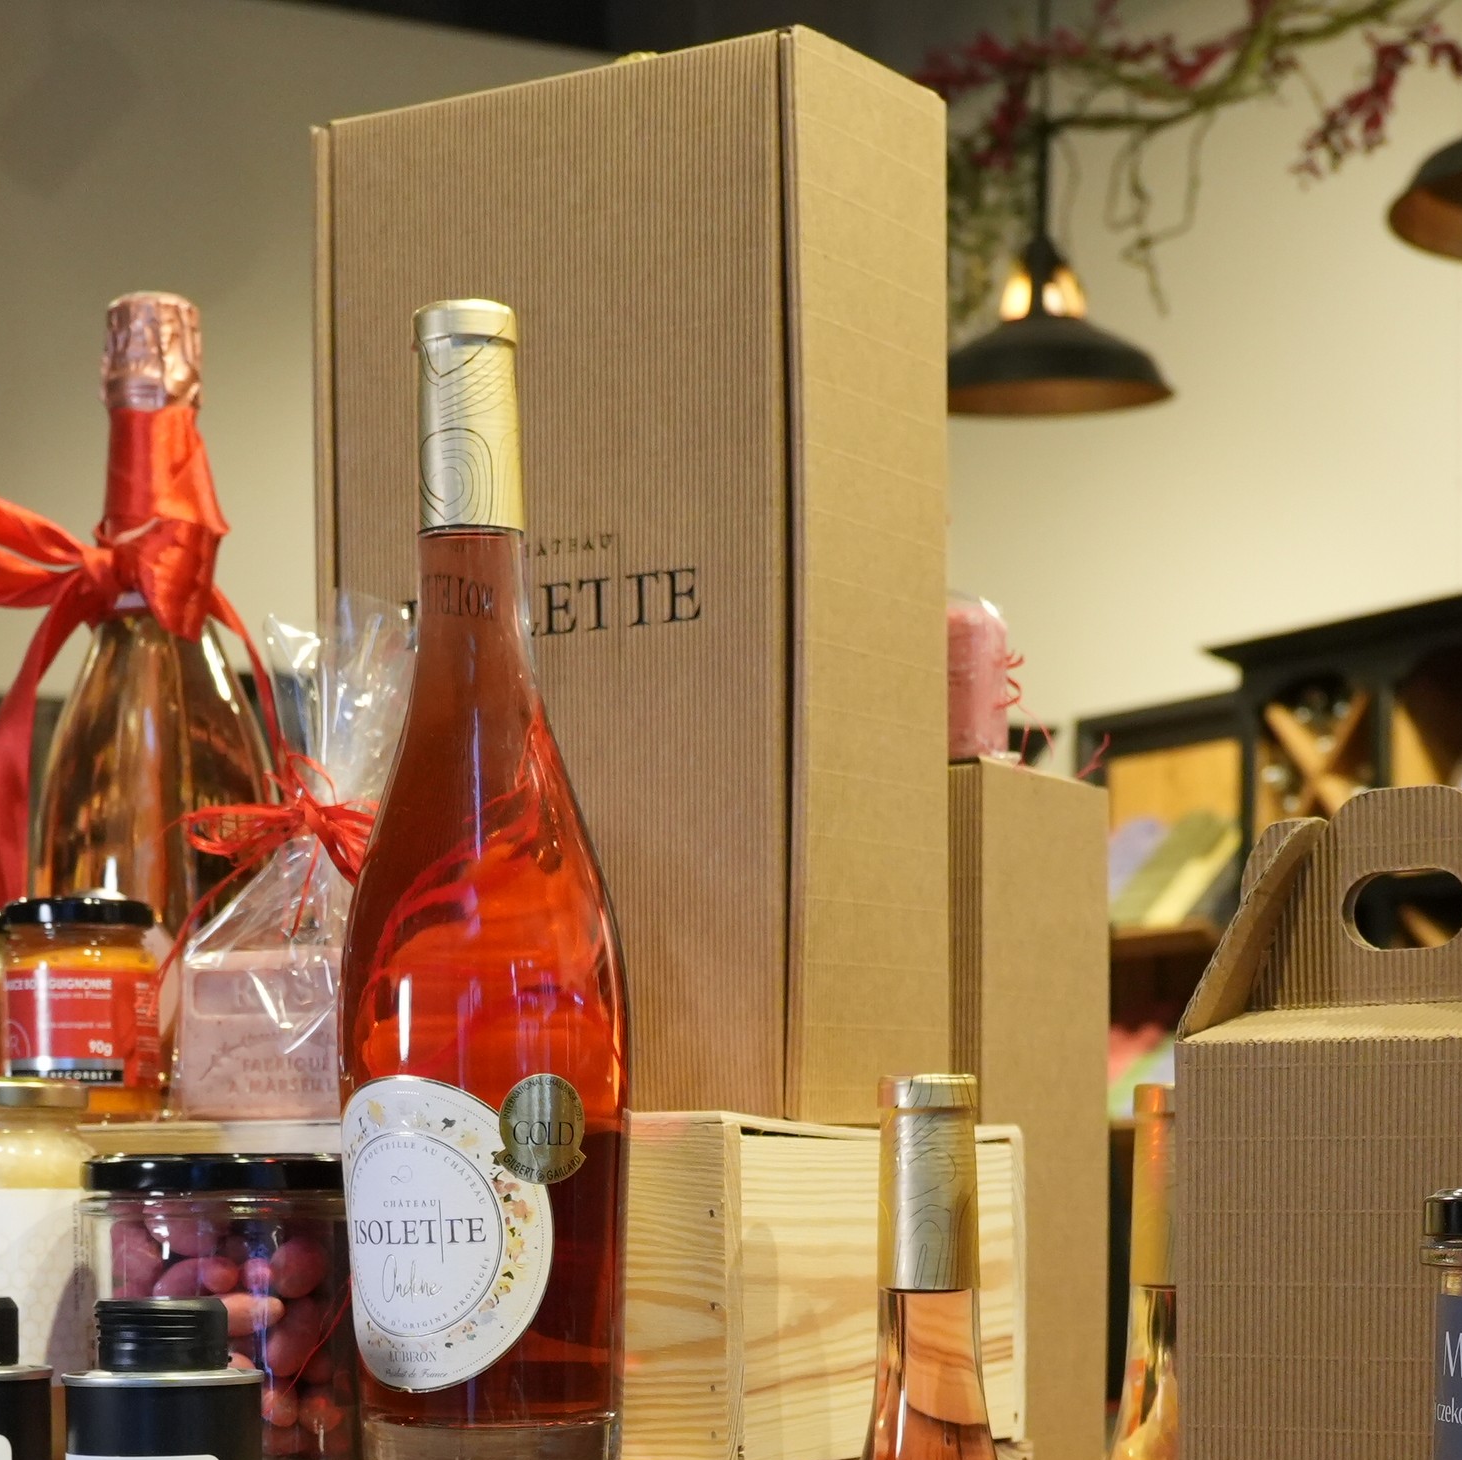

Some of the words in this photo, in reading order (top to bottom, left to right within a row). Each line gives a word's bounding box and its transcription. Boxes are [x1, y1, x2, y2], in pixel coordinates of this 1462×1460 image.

[531, 567, 701, 638] ETTE
[513, 1120, 574, 1146] GOLD
[422, 1147, 438, 1156] AU
[503, 1153, 534, 1179] GILBERT
[546, 1155, 582, 1181] GAILLARD
[354, 1217, 487, 1246] ISOLETTE
